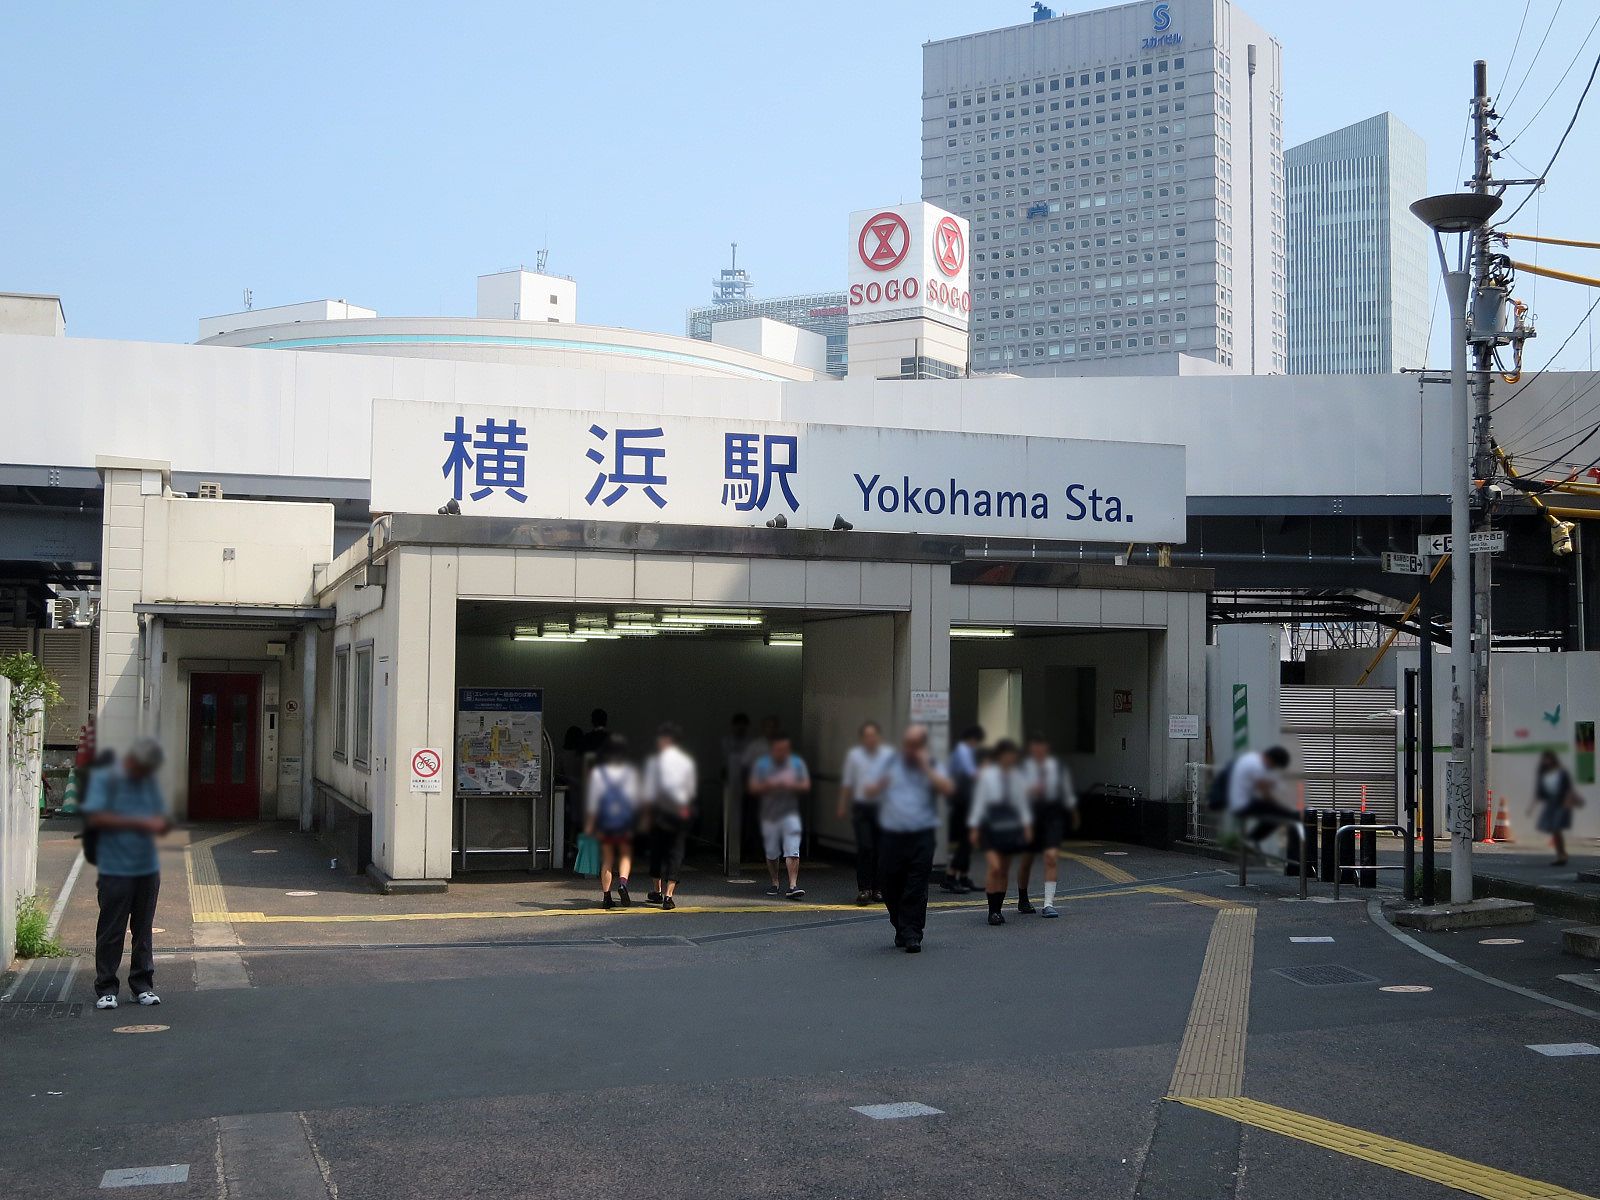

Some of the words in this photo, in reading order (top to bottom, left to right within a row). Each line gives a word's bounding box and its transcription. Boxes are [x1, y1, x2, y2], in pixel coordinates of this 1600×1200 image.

[1142, 33, 1182, 49] スカイビル
[849, 277, 919, 306] SOGO
[928, 278, 972, 312] SOGO
[441, 416, 800, 513] 横浜駅
[853, 473, 1049, 519] Yokohama
[1066, 484, 1134, 523] Sta.
